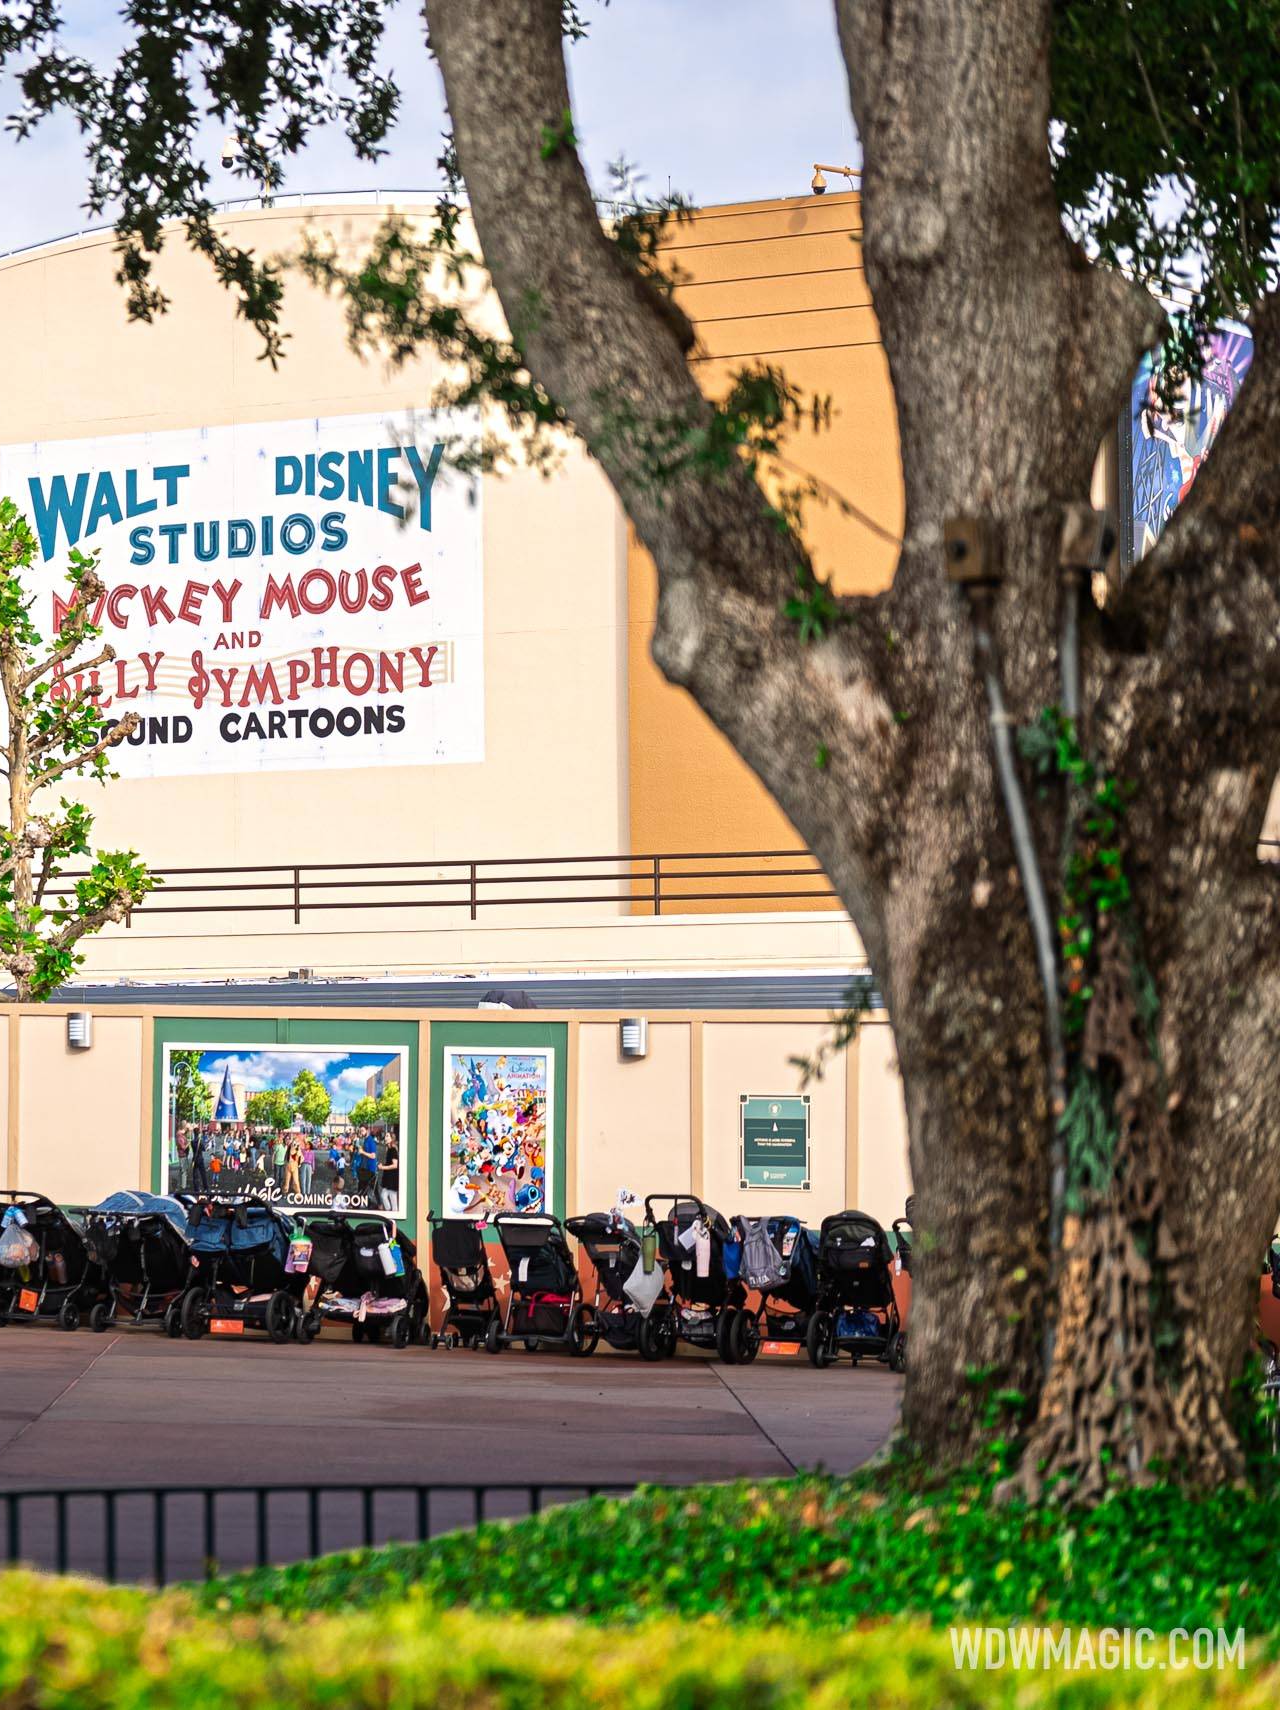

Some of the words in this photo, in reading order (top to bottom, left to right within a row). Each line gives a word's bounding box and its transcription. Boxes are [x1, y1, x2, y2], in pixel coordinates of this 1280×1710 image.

[27, 464, 190, 563] WALT
[275, 443, 446, 533] DISNEY
[129, 511, 349, 566] STUDIOS
[52, 578, 243, 634] MICKEY
[260, 562, 431, 620] MOUSE
[213, 630, 262, 651] AND
[187, 645, 439, 710] SYMPHONY
[219, 704, 406, 743] CARTOONS
[287, 1192, 332, 1206] COMING
